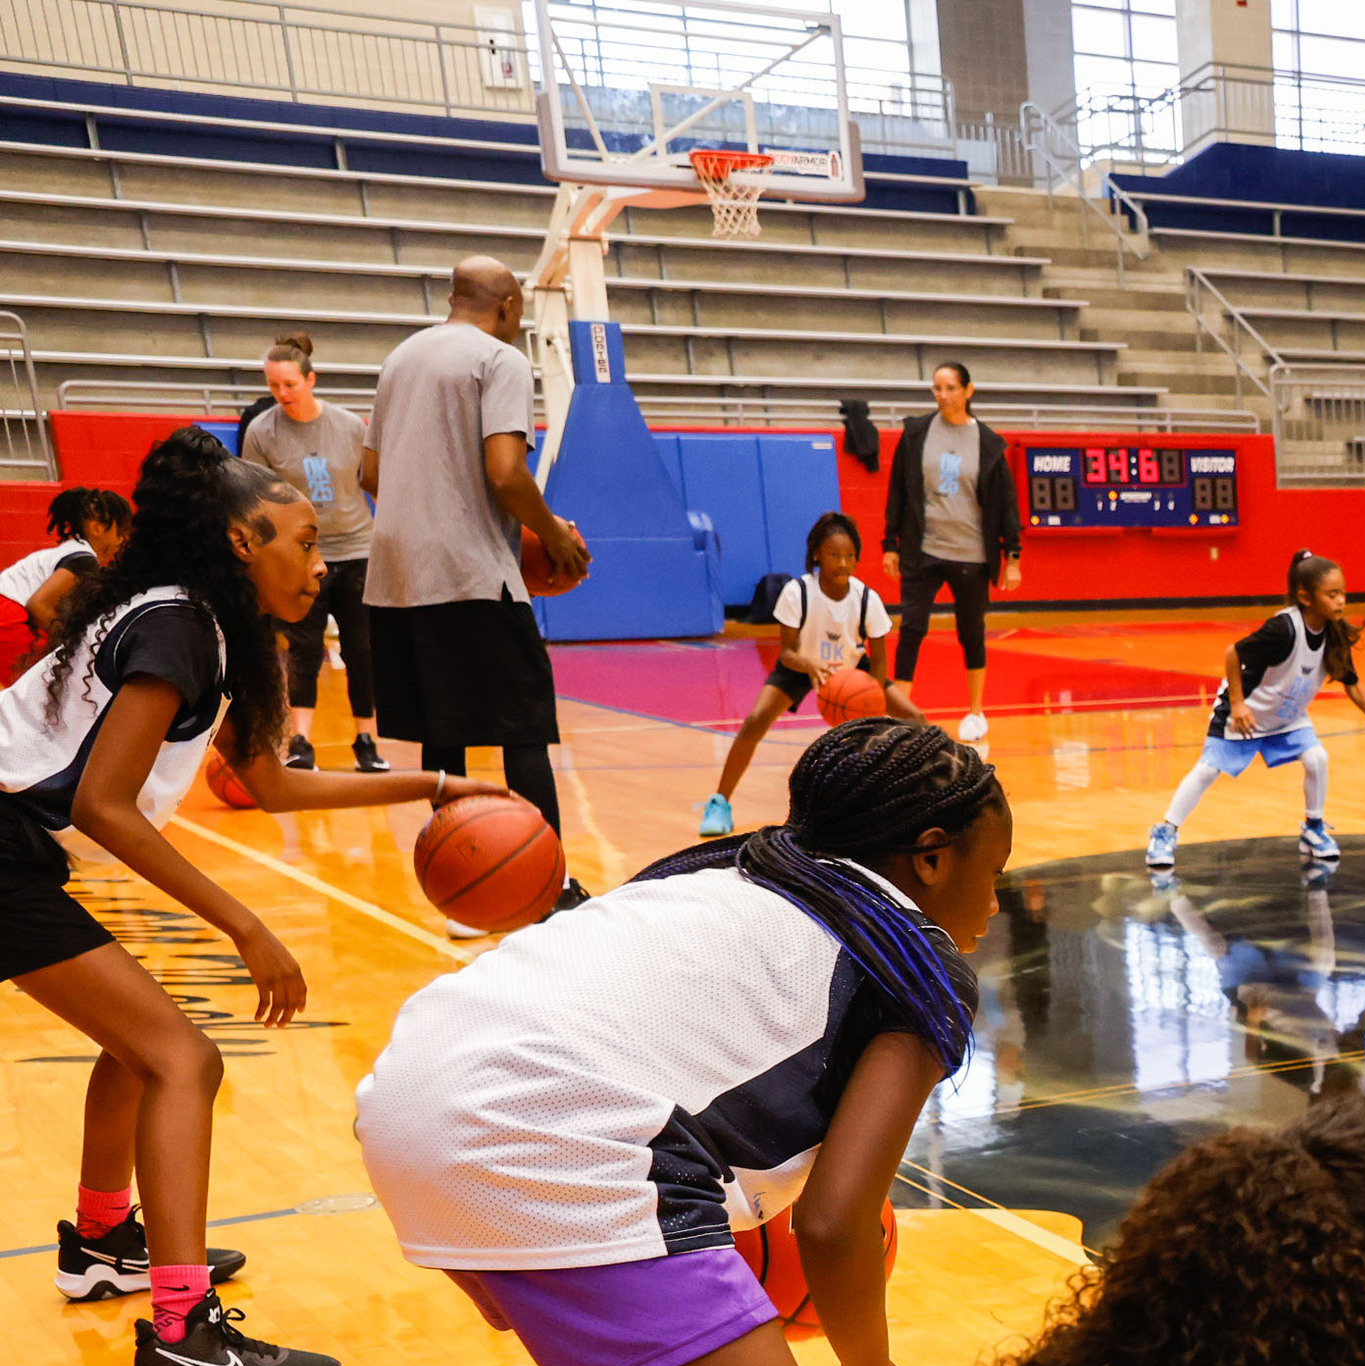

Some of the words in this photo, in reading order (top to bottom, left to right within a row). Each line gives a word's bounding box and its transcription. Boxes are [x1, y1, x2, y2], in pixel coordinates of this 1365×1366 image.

[302, 457, 330, 484] DK
[1033, 455, 1071, 472] HOME
[1190, 456, 1235, 473] VISITOR
[820, 641, 845, 660] DK
